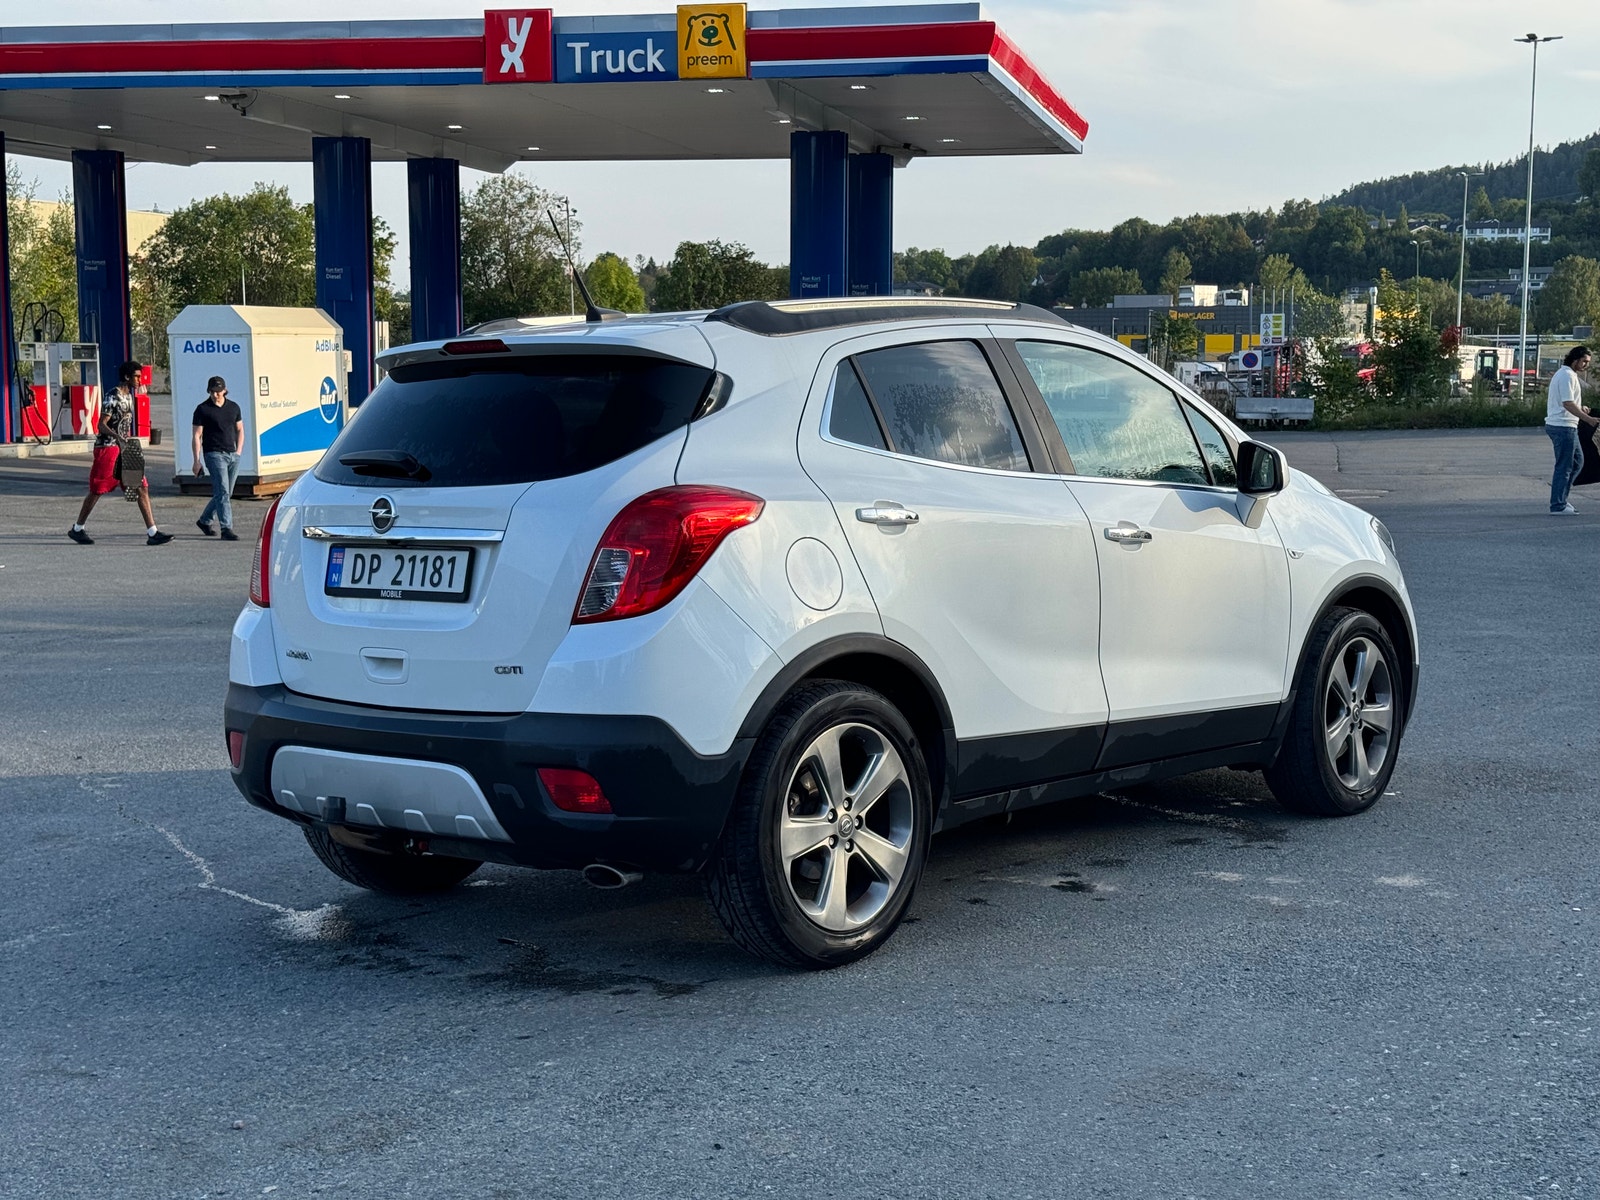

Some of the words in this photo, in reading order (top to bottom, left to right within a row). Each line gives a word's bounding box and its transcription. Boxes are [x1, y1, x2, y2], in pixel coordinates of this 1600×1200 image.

[567, 39, 666, 74] Truck
[687, 55, 733, 69] preem
[183, 339, 241, 353] AdBlue
[315, 340, 340, 352] AdBlue
[331, 573, 339, 582] N
[351, 553, 382, 585] DP
[391, 554, 457, 588] 21181
[380, 590, 403, 598] MOBILE
